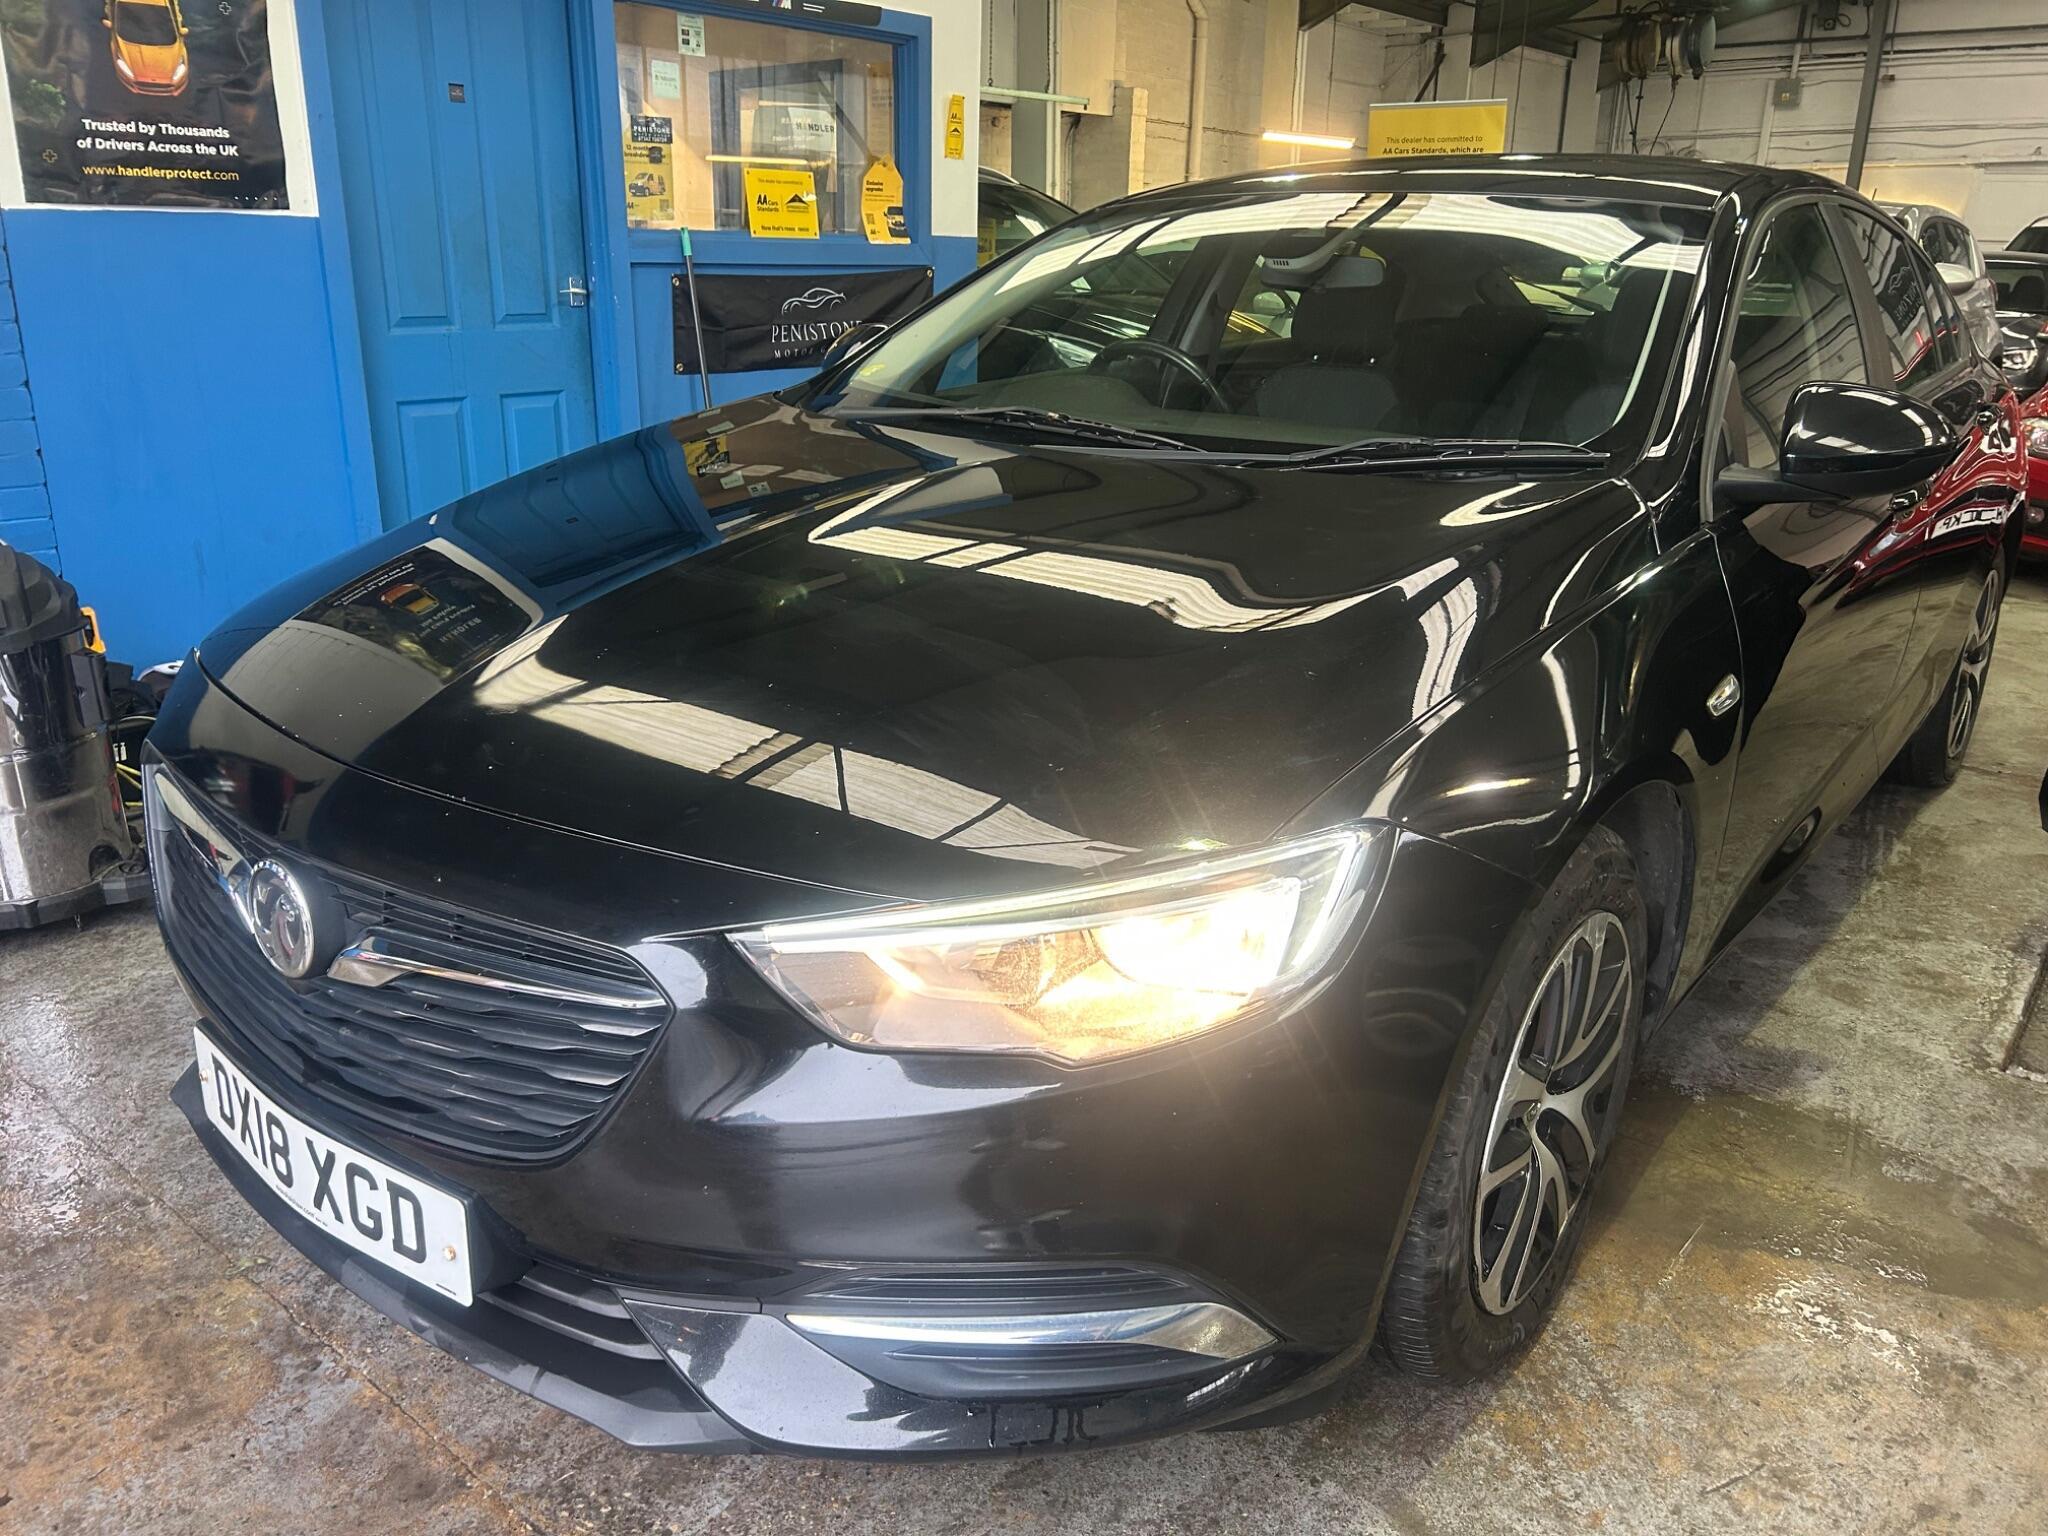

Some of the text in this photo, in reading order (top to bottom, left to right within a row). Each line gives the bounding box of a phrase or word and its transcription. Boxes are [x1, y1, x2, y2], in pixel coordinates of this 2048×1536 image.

[81, 119, 230, 138] Trusted by Thousands
[796, 122, 834, 133] HNDLER
[76, 137, 239, 156] of Drivers Across the UK
[82, 165, 239, 180] www.handlerprotect.com
[757, 194, 768, 206] AA
[771, 320, 862, 343] PENISTON
[211, 1054, 427, 1264] DX18 XGD
